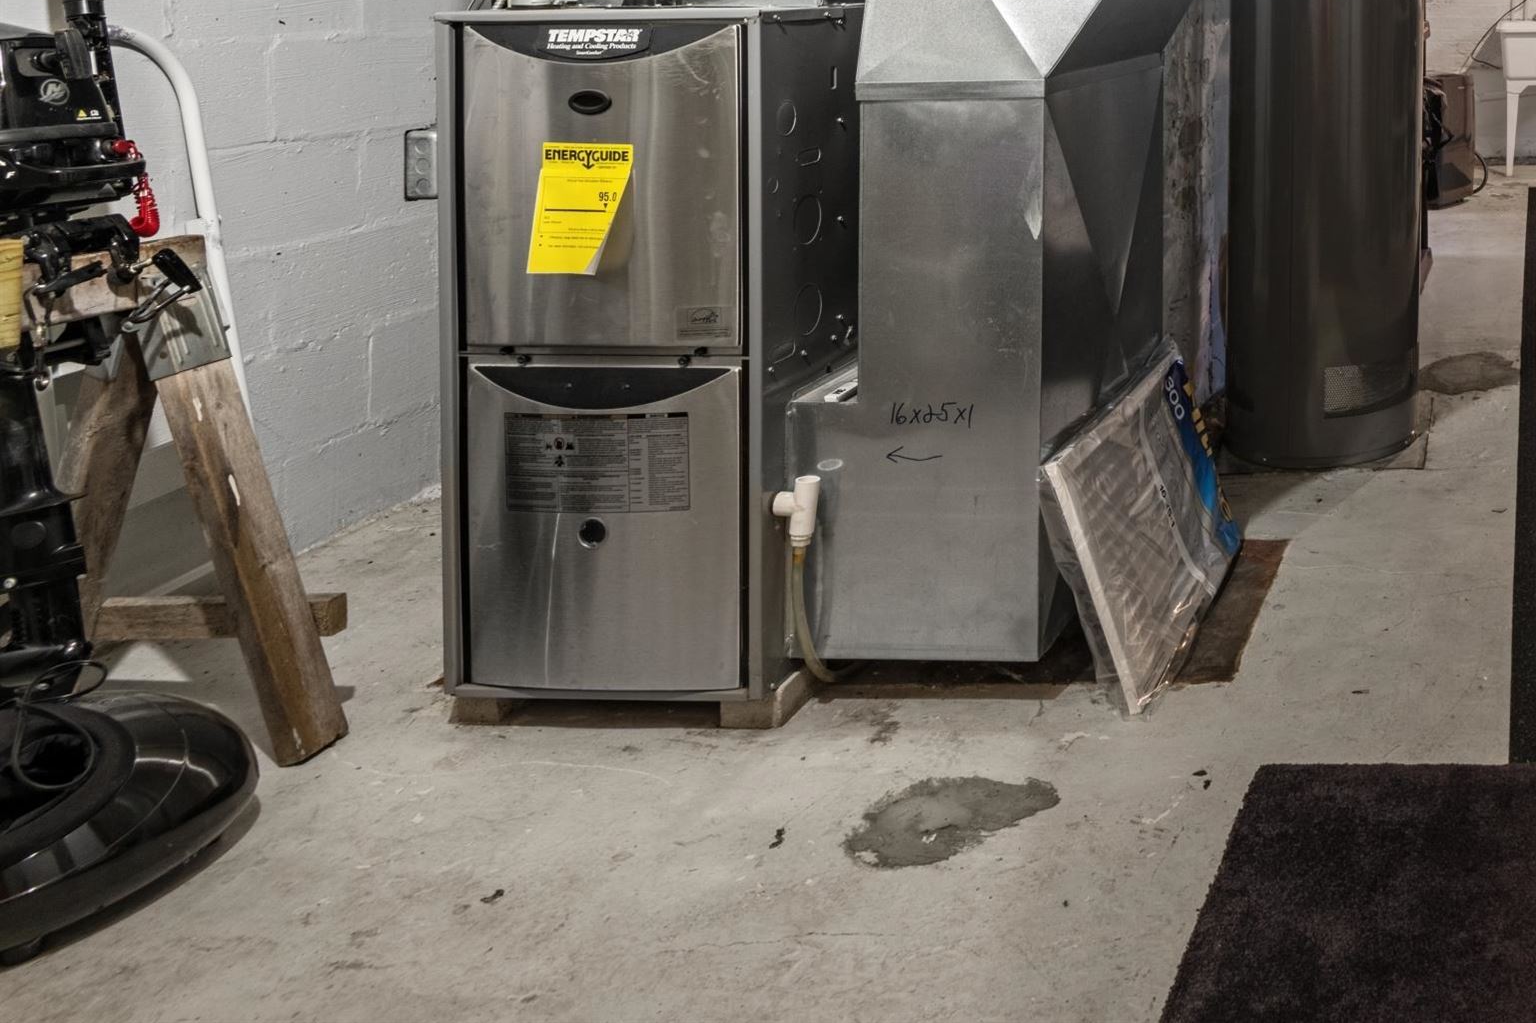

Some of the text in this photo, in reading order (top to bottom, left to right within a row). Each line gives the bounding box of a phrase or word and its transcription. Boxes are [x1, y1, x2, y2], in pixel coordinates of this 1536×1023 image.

[548, 28, 640, 42] TEMPSTAR
[544, 149, 629, 163] ENERGYGUIDE
[598, 192, 617, 202] 95.0
[1165, 376, 1185, 420] 300
